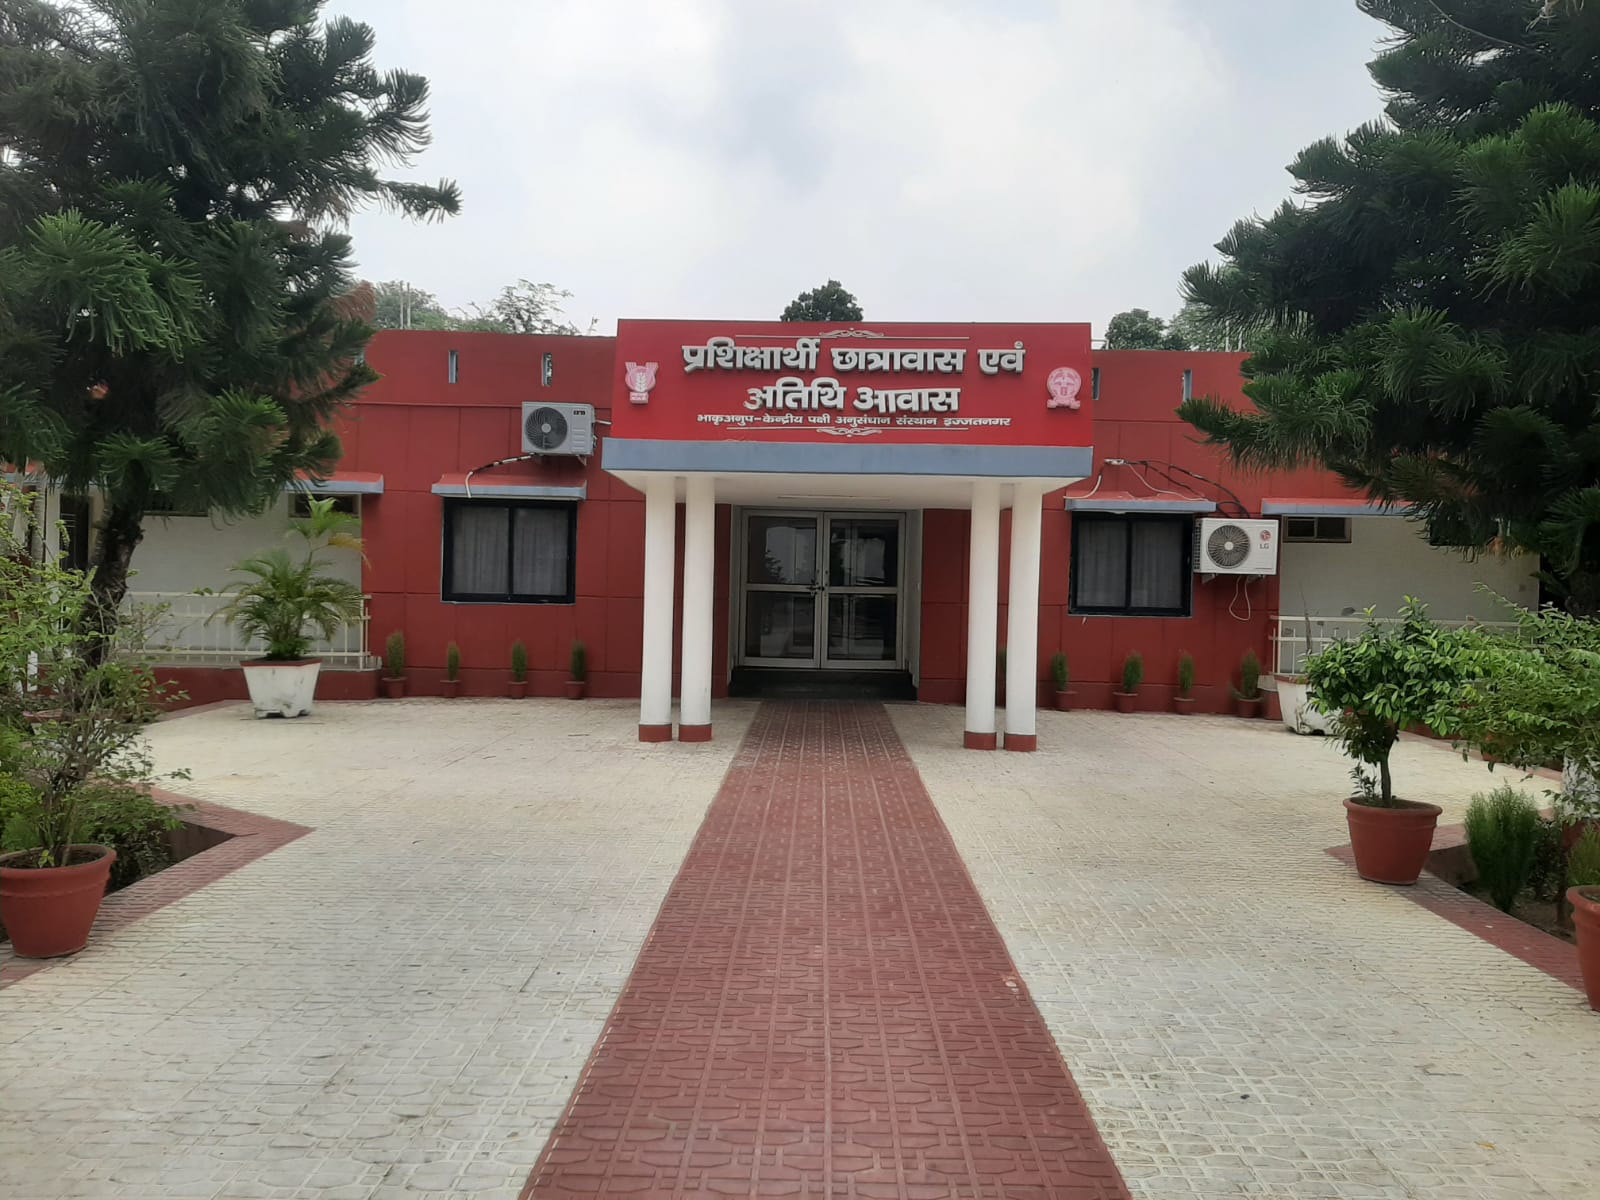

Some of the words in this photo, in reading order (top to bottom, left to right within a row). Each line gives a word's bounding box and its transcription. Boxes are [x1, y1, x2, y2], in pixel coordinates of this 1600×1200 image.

[830, 347, 967, 374] छात्रावास
[978, 340, 1026, 375] एवं
[744, 376, 847, 412] अतिथि
[853, 385, 961, 414] आवास
